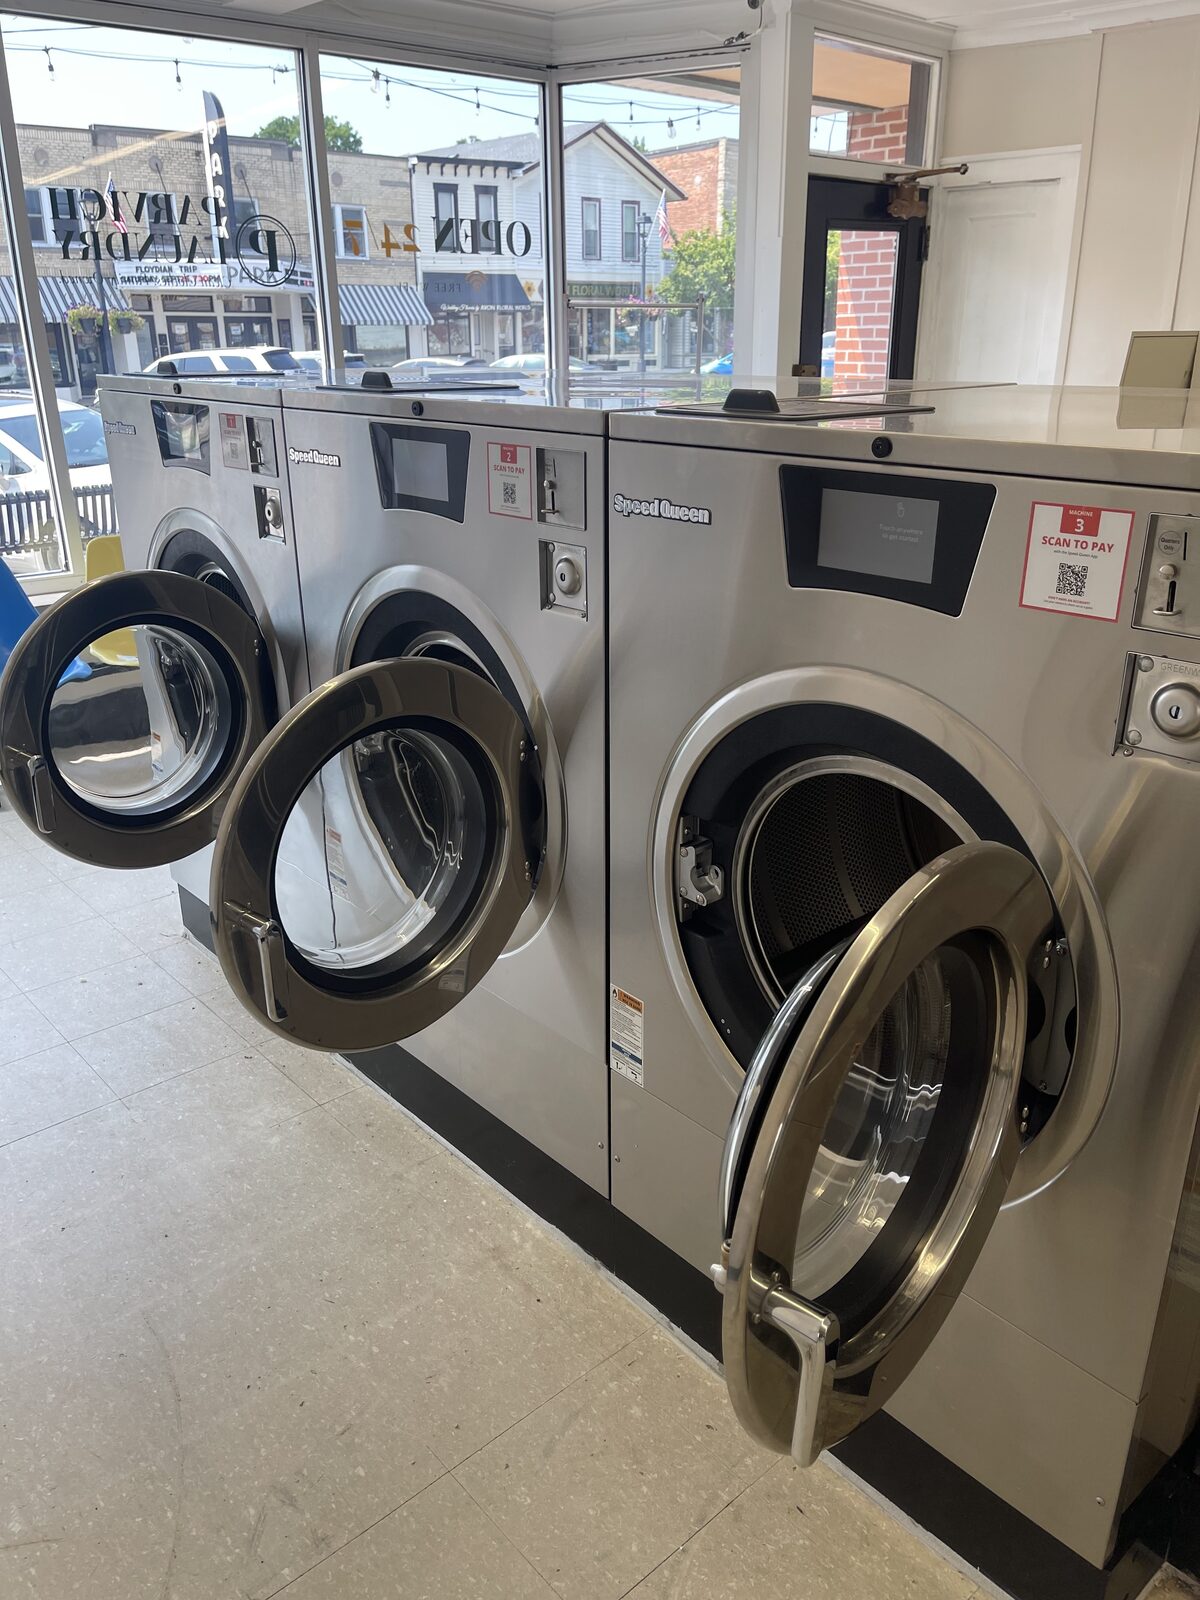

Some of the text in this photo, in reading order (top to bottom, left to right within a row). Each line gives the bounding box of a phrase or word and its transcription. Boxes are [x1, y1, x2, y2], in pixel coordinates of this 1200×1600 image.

[135, 265, 198, 274] FLOYDIAN TRIP
[572, 285, 605, 296] FLORAL
[289, 447, 341, 467] Speed Queen
[506, 452, 512, 462] 2
[493, 464, 507, 472] SCAN
[515, 467, 525, 475] PAY
[613, 493, 711, 525] Speed Queen
[1068, 509, 1094, 517] MACHINE
[1074, 518, 1085, 532] 3
[1041, 536, 1114, 553] SCAN TO PAY
